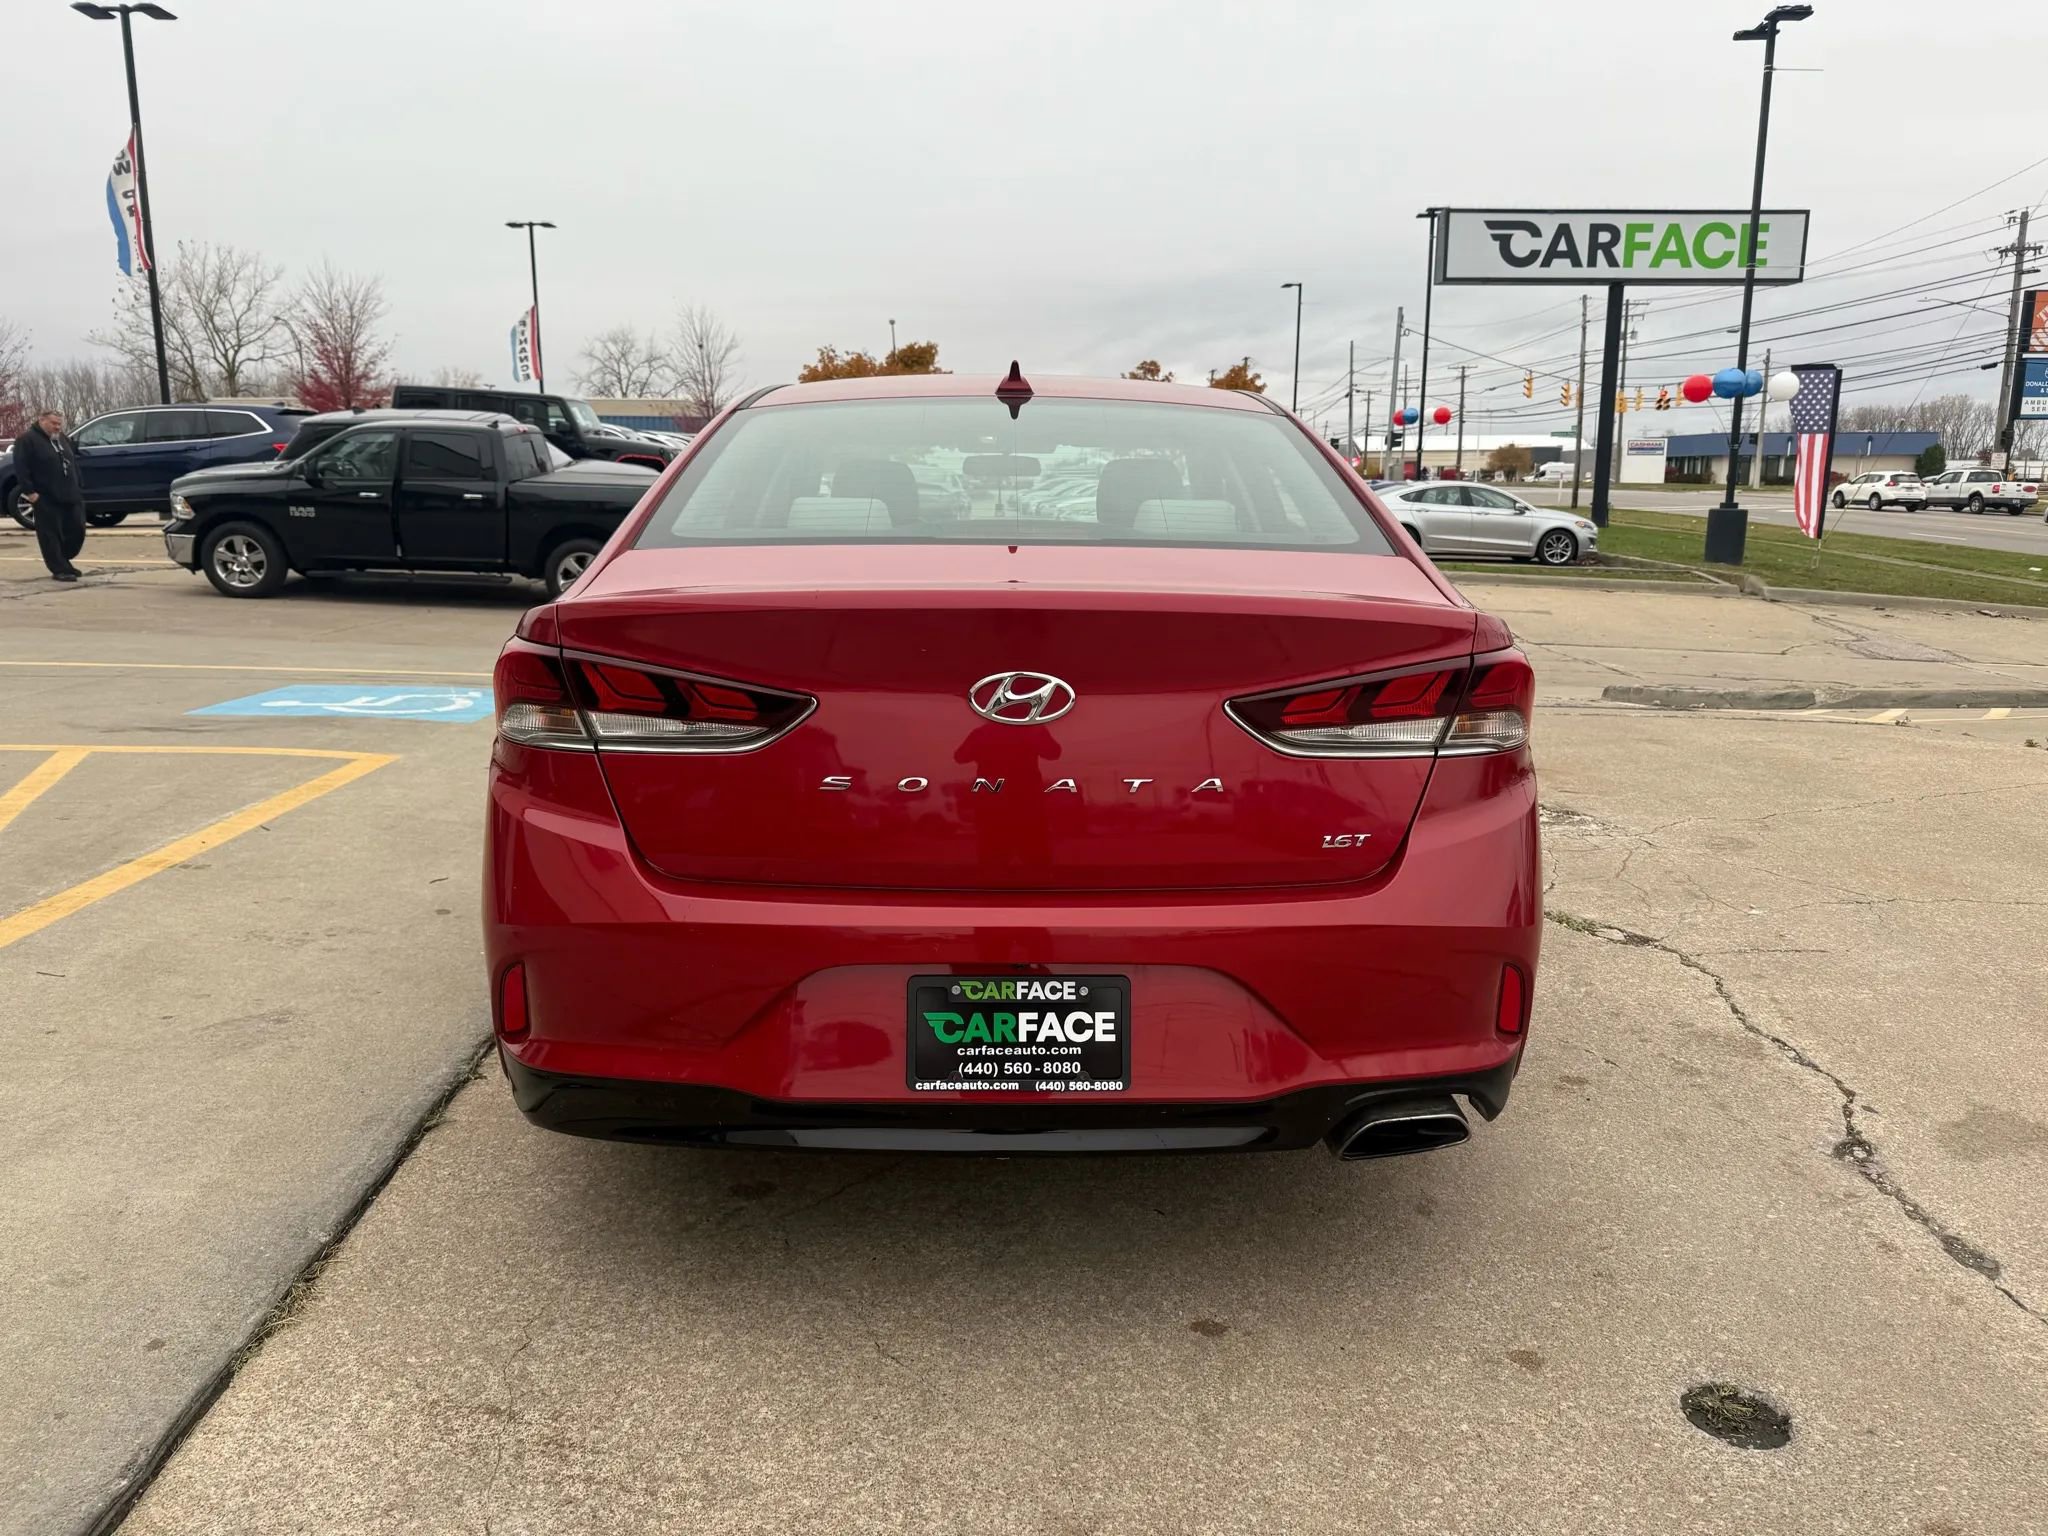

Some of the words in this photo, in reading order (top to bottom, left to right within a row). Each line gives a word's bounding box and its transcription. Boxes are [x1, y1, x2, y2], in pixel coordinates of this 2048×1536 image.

[1483, 220, 1770, 269] CARFACE
[818, 775, 1225, 793] SONATA
[959, 980, 1076, 1000] CARFACE
[923, 1011, 1116, 1043] CARFACE
[957, 1044, 1082, 1056] carfaceauto.com
[958, 1062, 999, 1077] (440)
[915, 1080, 1019, 1091] carfaceauto.com
[1035, 1081, 1065, 1092] (440)
[1069, 1081, 1123, 1091] 560-8080
